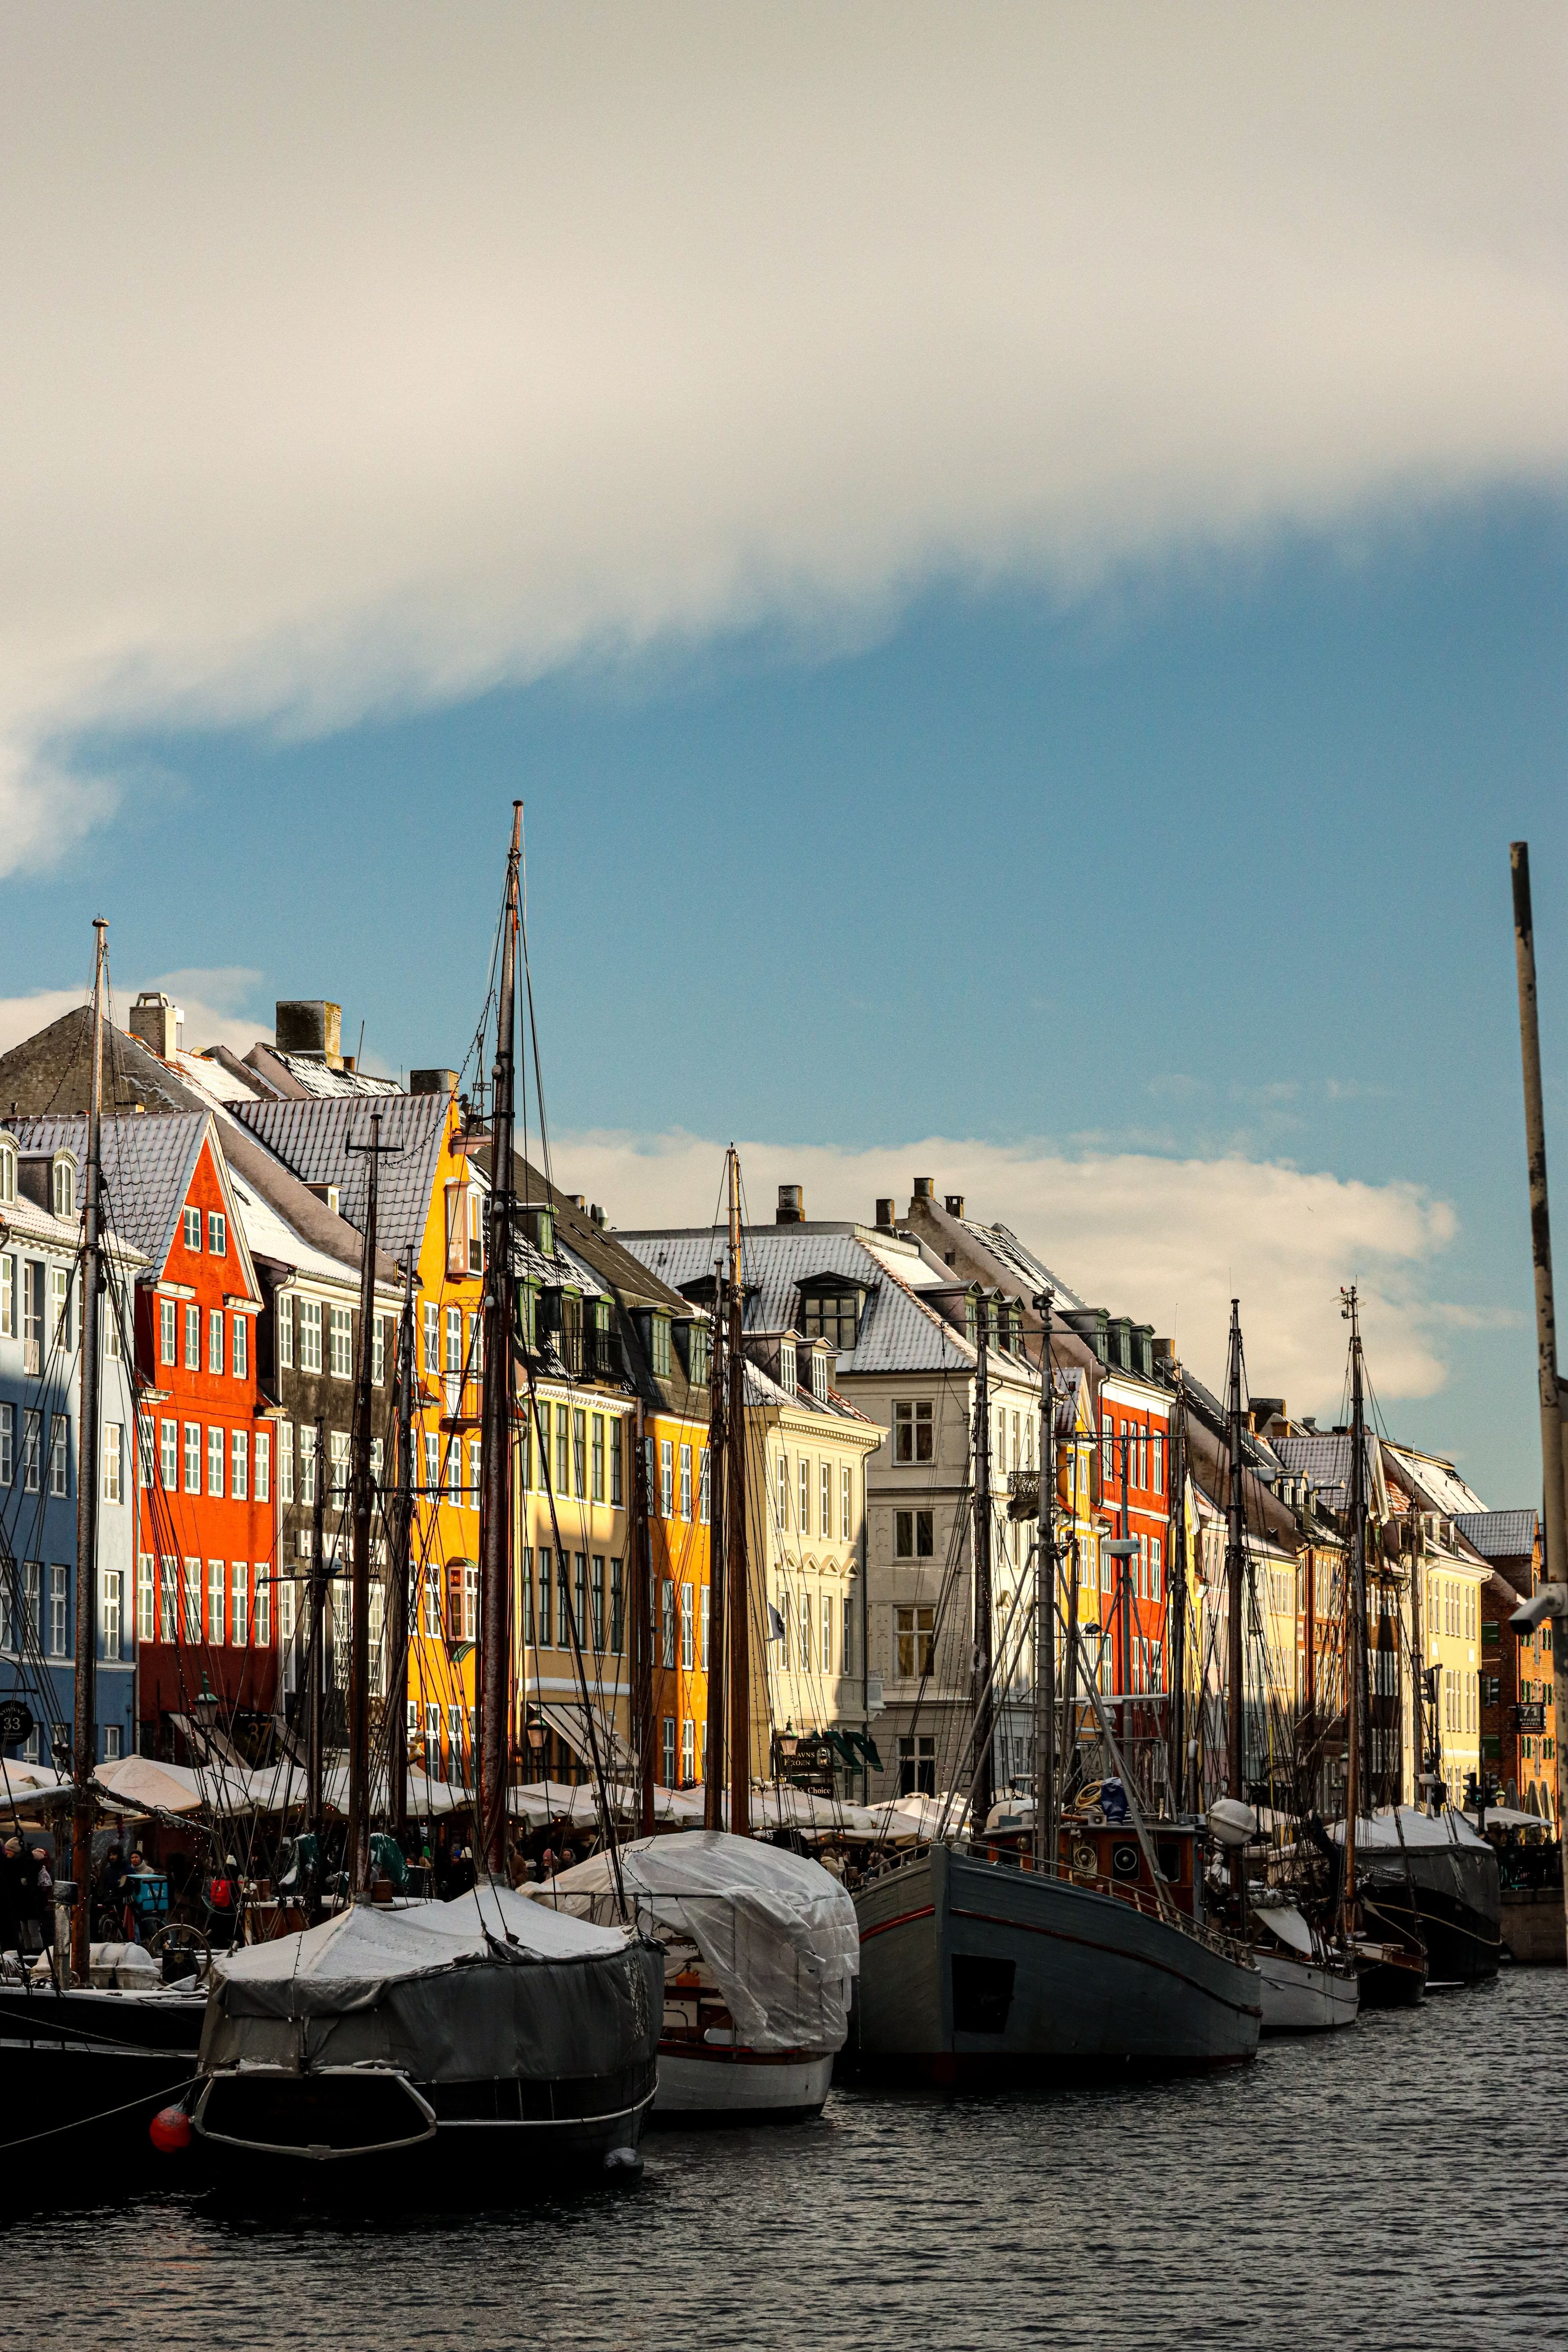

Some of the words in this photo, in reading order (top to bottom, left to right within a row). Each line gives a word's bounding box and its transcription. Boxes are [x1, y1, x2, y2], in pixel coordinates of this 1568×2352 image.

[1522, 1707, 1537, 1717] 71
[3, 1717, 20, 1730] 33
[248, 1722, 272, 1746] 37
